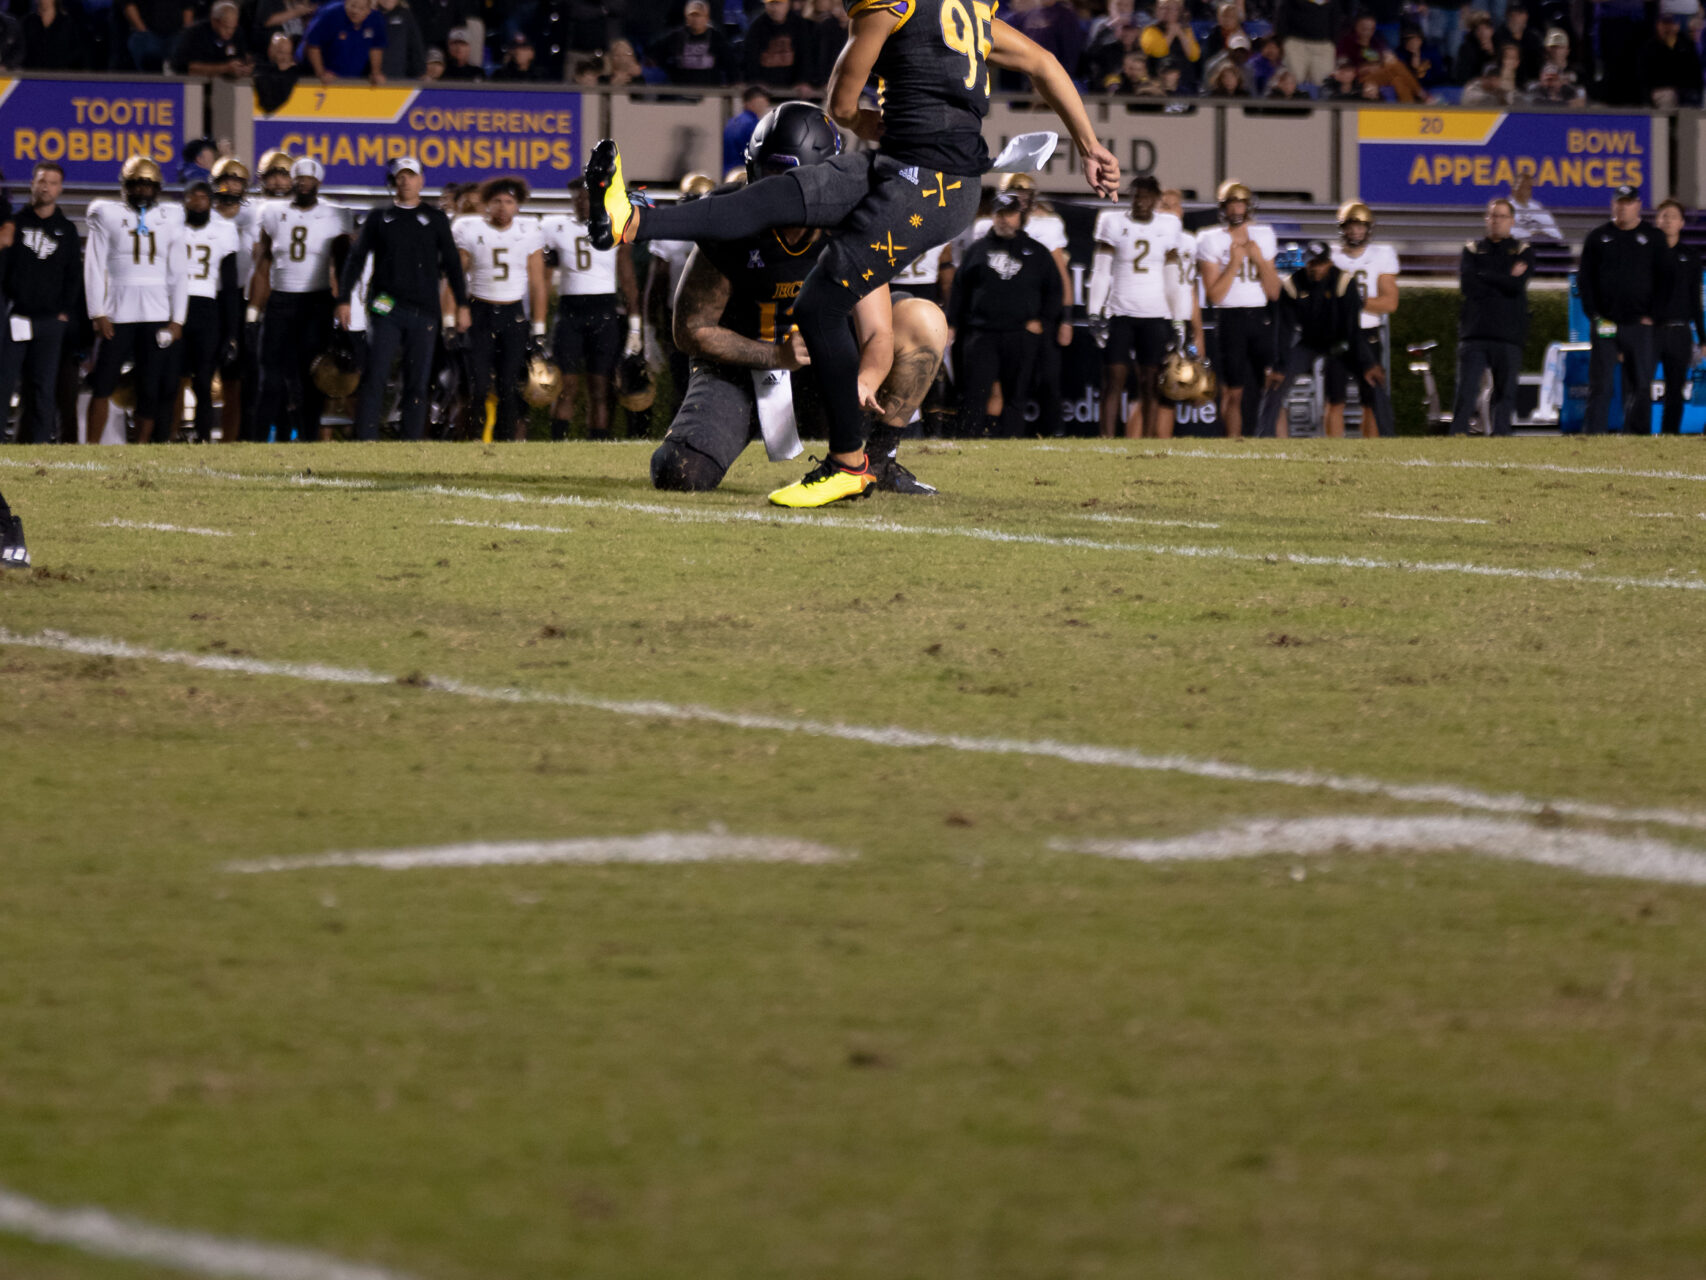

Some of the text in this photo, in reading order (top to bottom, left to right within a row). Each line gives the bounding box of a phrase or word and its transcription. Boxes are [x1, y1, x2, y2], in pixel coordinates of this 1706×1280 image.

[71, 97, 175, 126] TOOTIE
[315, 92, 326, 111] 7
[408, 108, 571, 134] CONFERENCE
[1419, 117, 1444, 134] 20
[14, 128, 174, 163] ROBBINS
[280, 132, 571, 170] CHAMPIONSHIPS
[1046, 137, 1157, 175] FILD
[1567, 128, 1643, 154] BOWL
[129, 231, 156, 265] 11
[290, 226, 308, 261] 8
[575, 237, 592, 271] 6
[1133, 240, 1150, 273] 2
[187, 245, 211, 279] 3
[492, 248, 509, 281] 5
